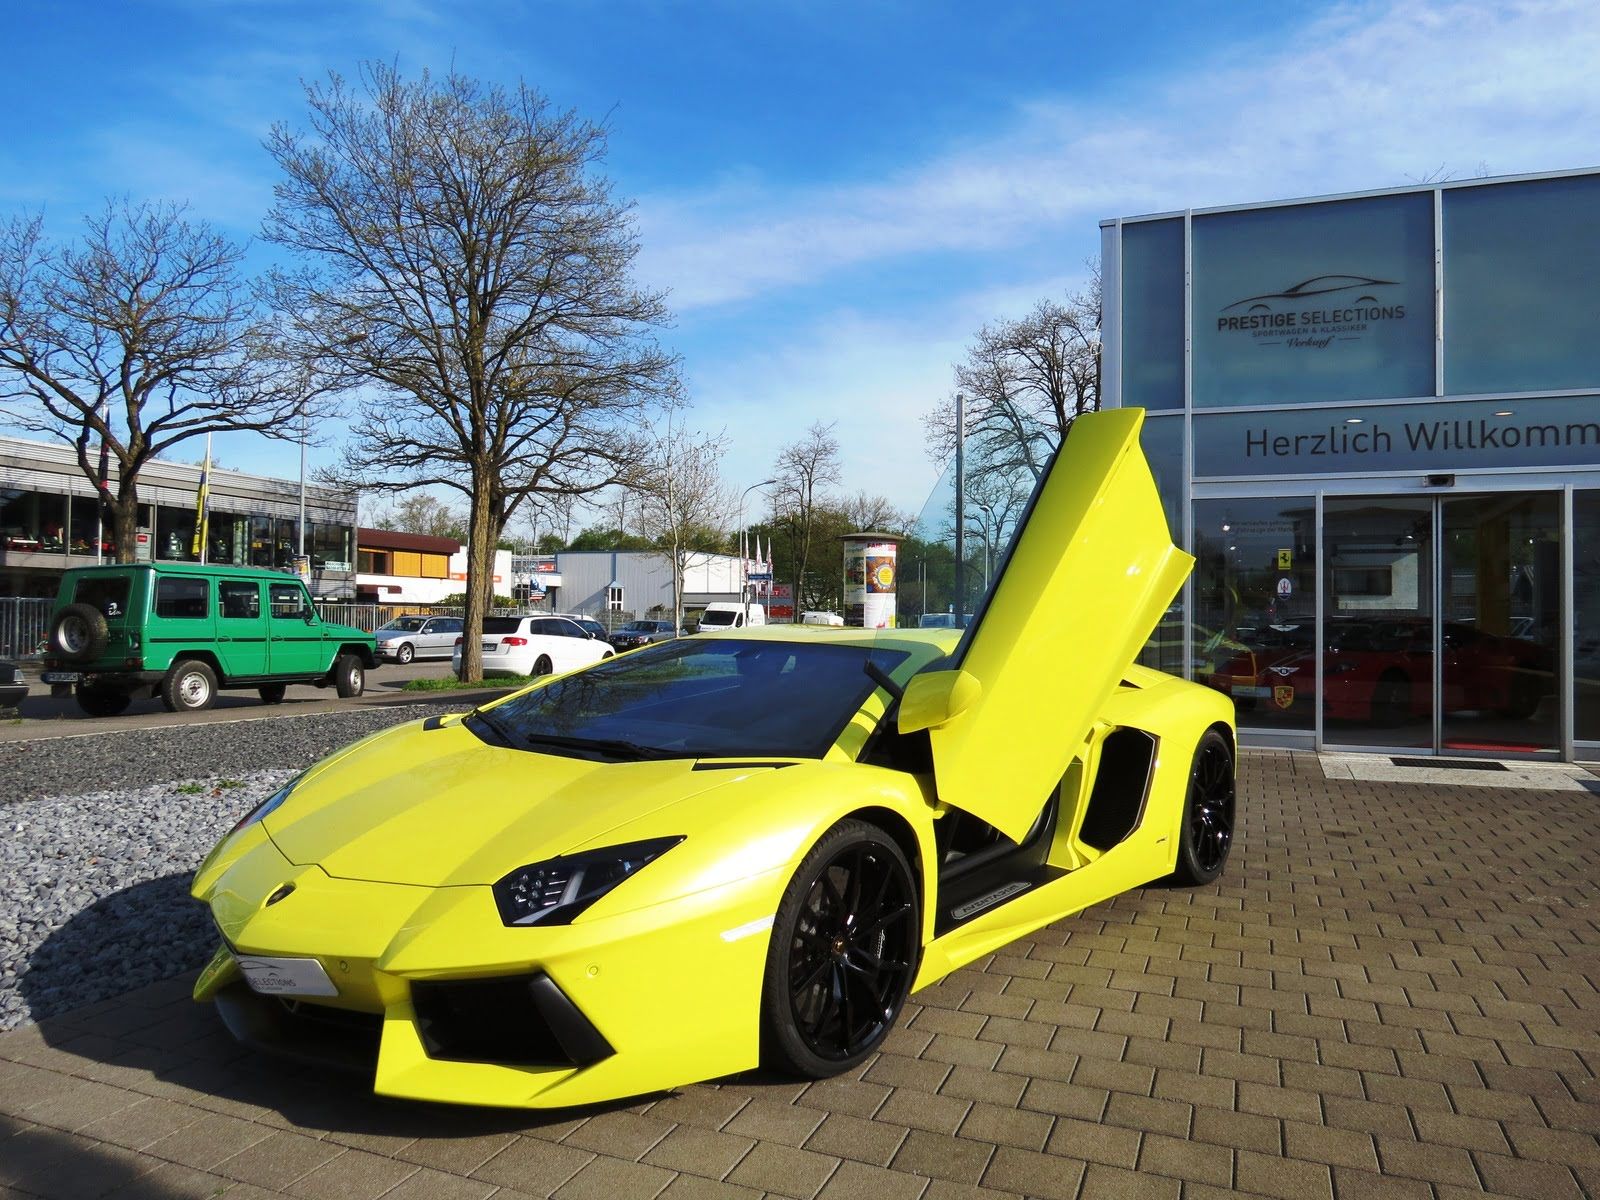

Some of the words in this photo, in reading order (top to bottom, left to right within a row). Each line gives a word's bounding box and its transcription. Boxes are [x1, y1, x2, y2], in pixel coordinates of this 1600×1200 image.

[1217, 312, 1296, 332] PRESTIGE
[1301, 305, 1406, 325] SELECTIONS
[1252, 327, 1309, 337] SPORTWAGEN
[1311, 326, 1317, 334] &
[1320, 323, 1367, 334] KLASSIKER
[1286, 336, 1335, 349] Verkauf
[1246, 424, 1392, 458] Herzlich
